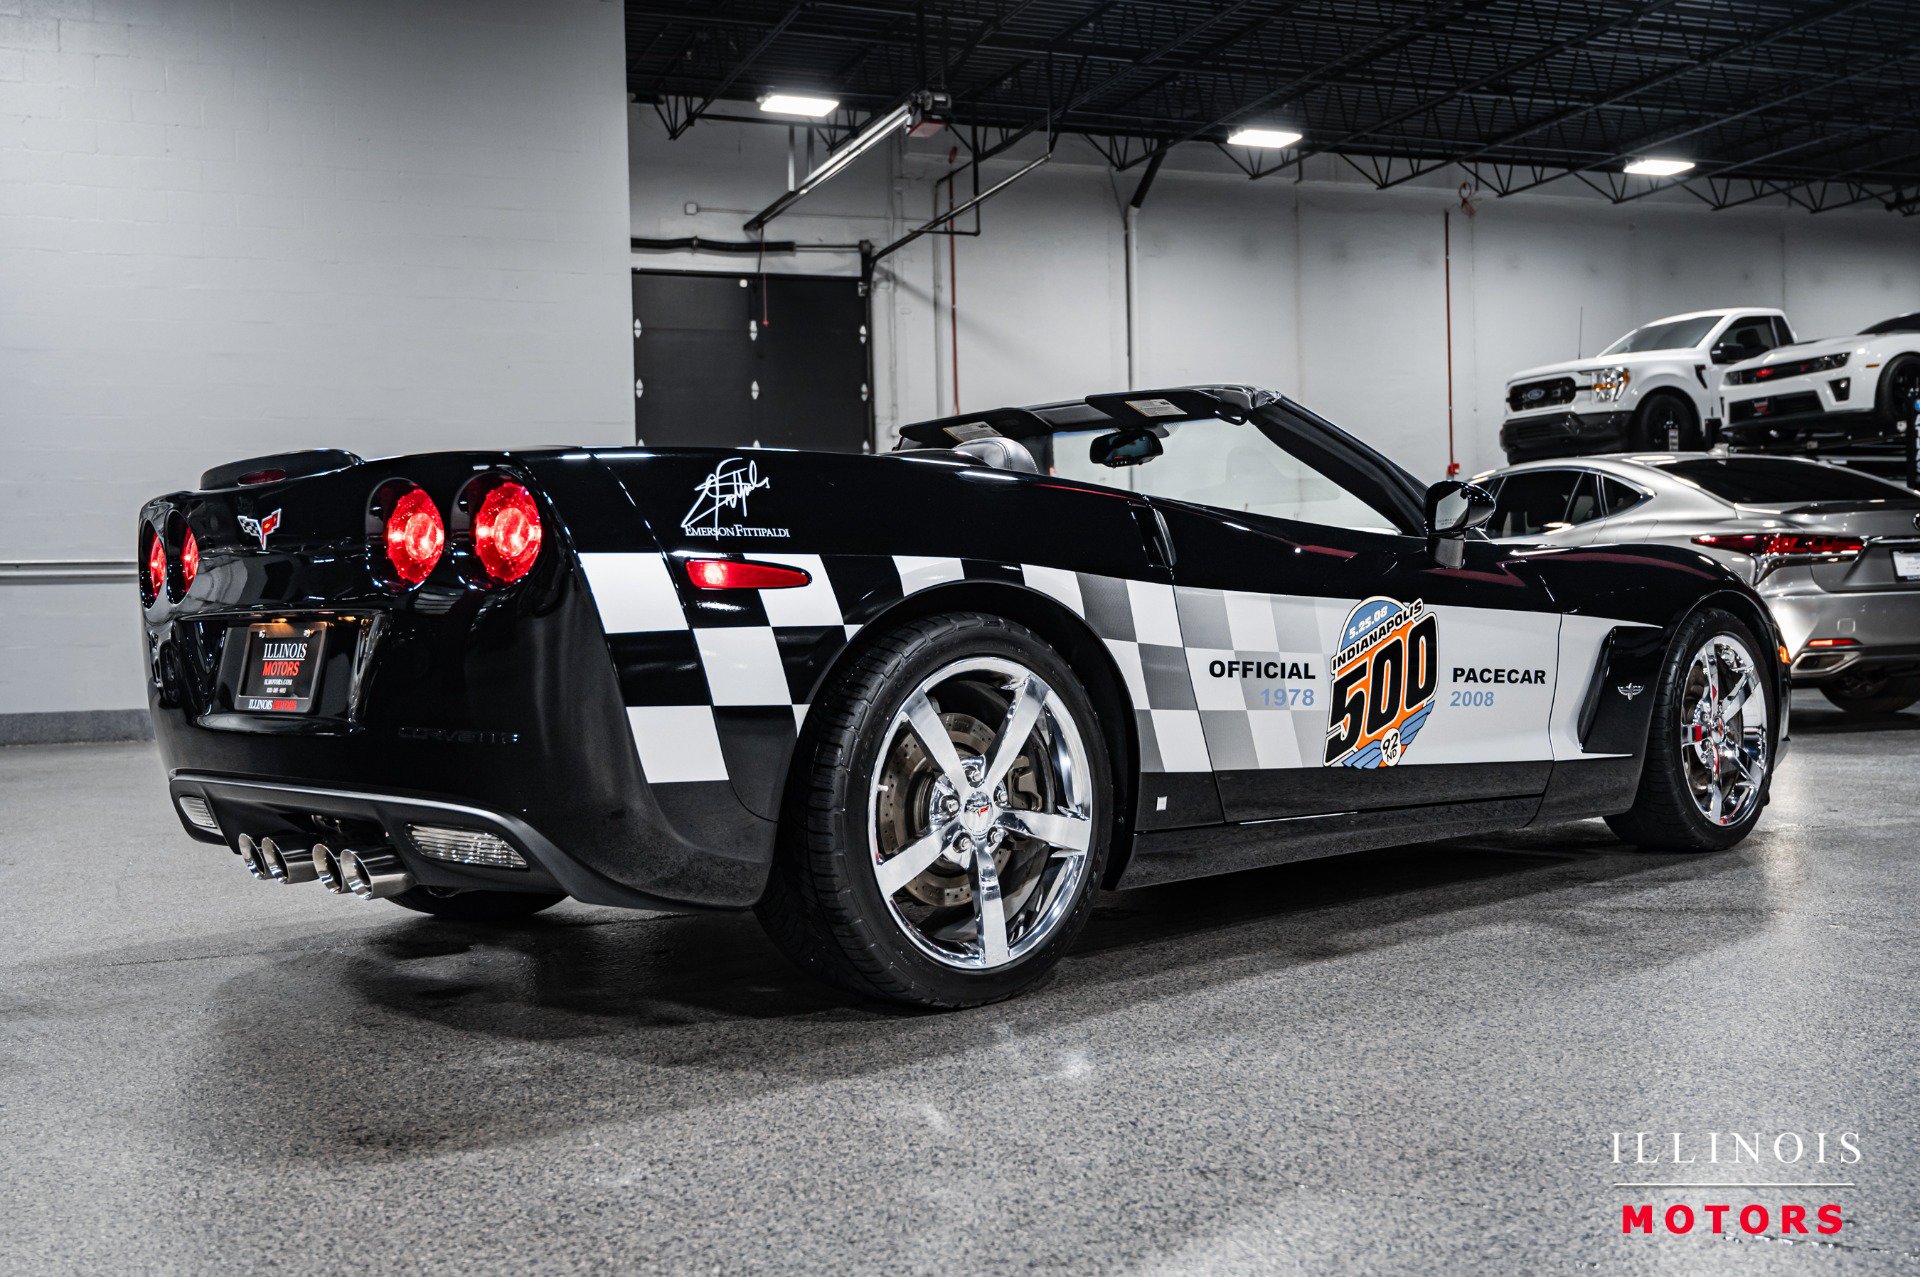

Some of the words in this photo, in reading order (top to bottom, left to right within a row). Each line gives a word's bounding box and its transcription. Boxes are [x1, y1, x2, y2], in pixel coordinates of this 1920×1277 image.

[685, 524, 734, 537] EMERSON
[734, 524, 790, 538] FITTIPALDI
[1348, 605, 1388, 639] 5.25.08
[1332, 600, 1422, 671] INDIANAPOLIS
[263, 643, 308, 658] ILLINOIS
[262, 661, 300, 676] MOTORS
[1209, 660, 1316, 679] OFFICIAL
[1452, 667, 1546, 684] PACECAR
[1260, 688, 1315, 706] 1978
[1324, 613, 1438, 765] 500
[248, 699, 273, 709] ILLINOIS
[1450, 690, 1495, 707] 2008
[1382, 732, 1399, 755] 92
[1386, 748, 1397, 762] ND
